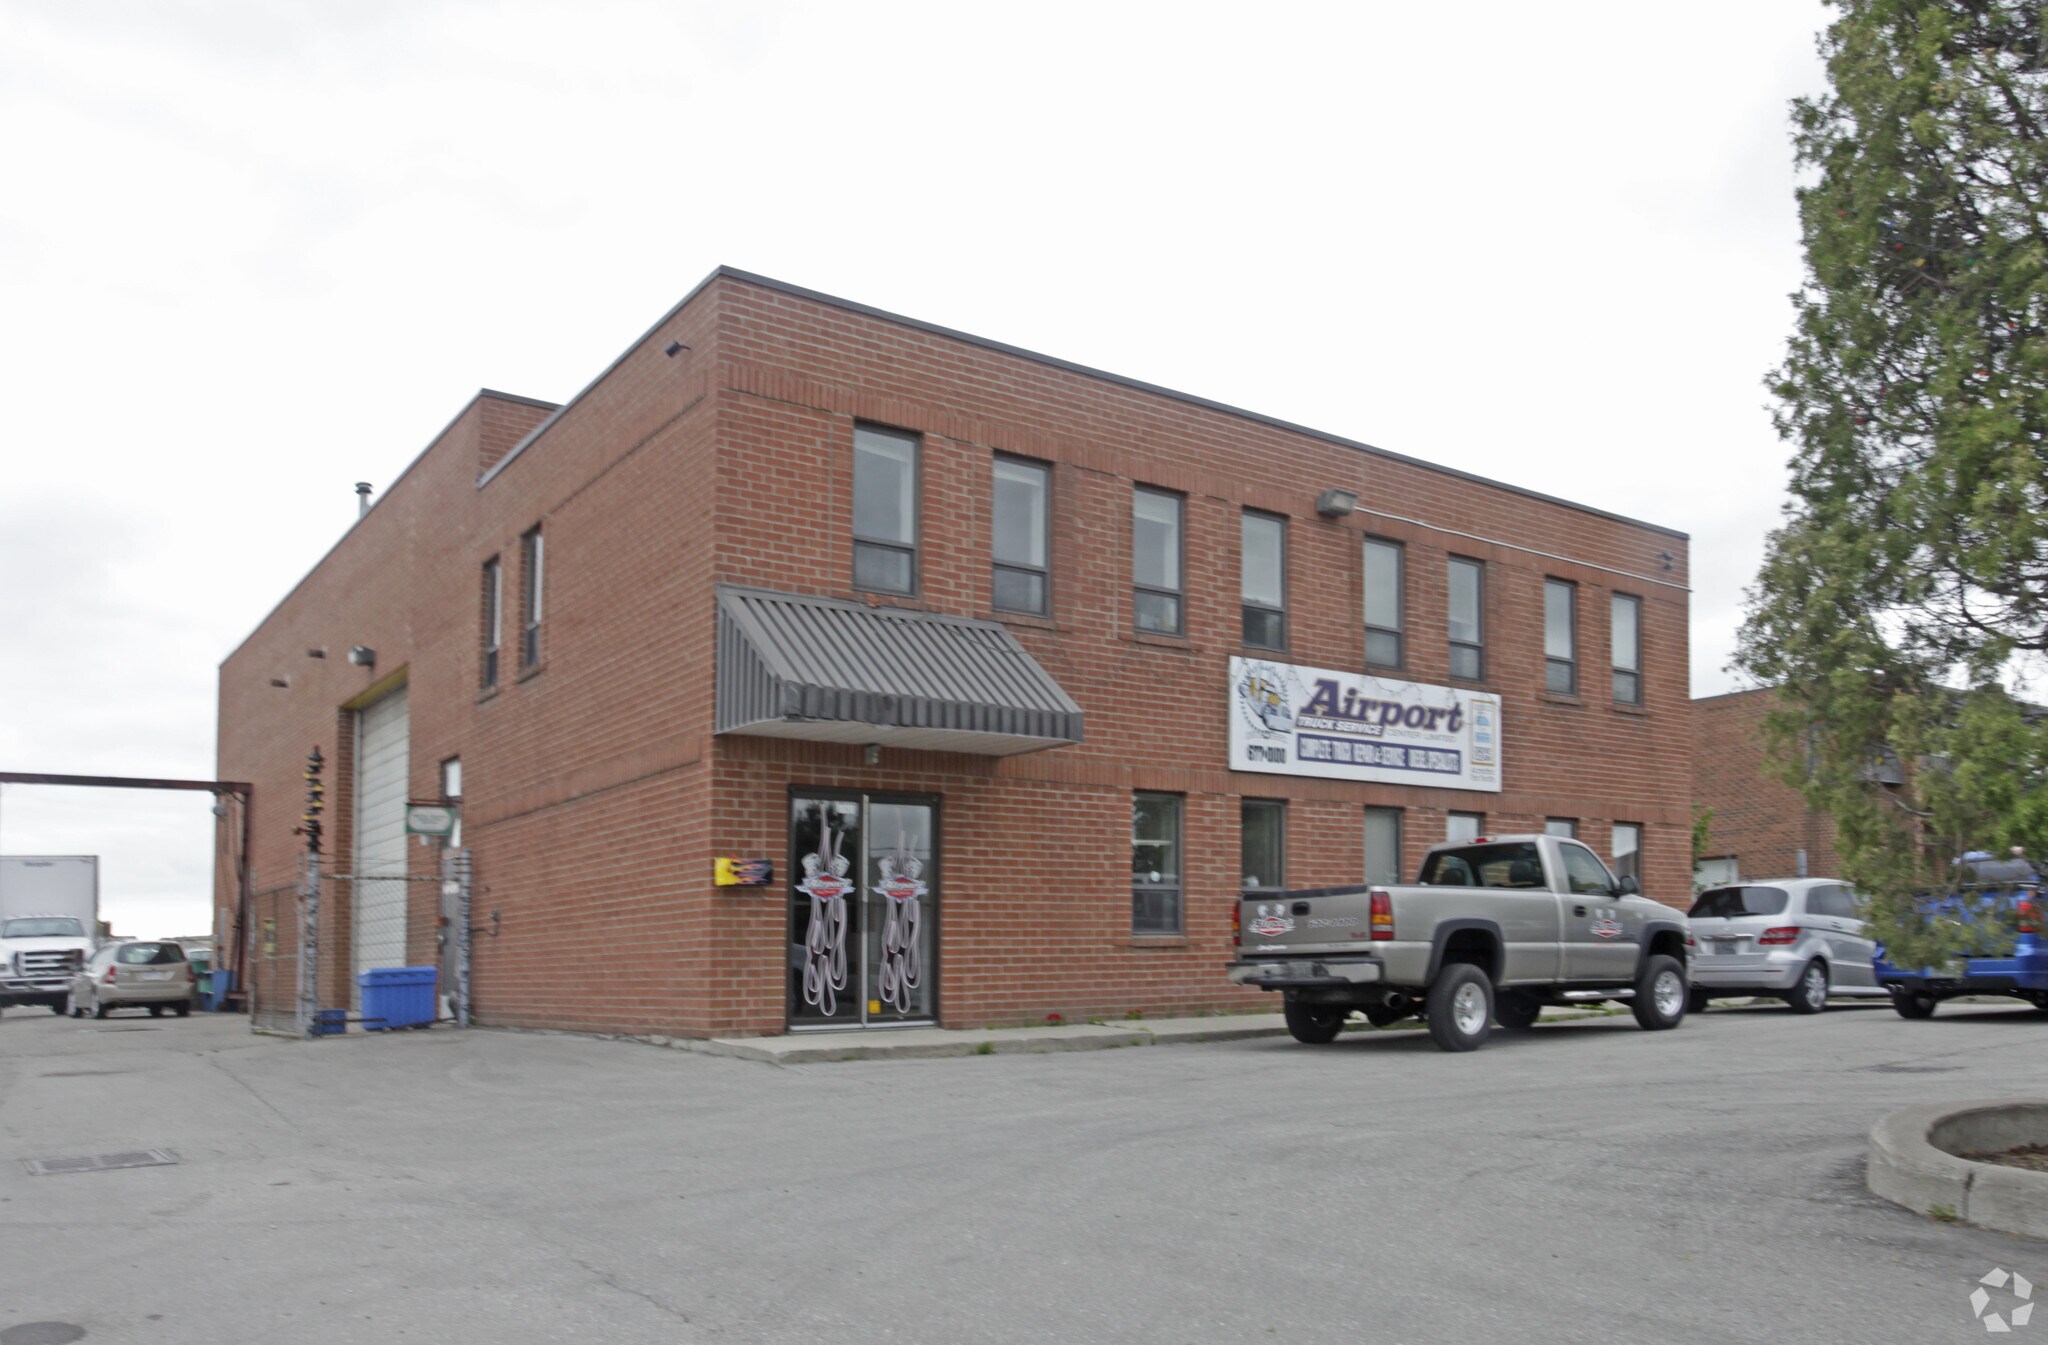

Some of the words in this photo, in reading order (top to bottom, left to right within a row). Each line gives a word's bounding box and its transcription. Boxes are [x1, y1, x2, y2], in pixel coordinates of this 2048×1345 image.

[1299, 678, 1464, 734] Airport
[1297, 716, 1334, 730] TRUCK
[1334, 720, 1384, 736] SERVICE
